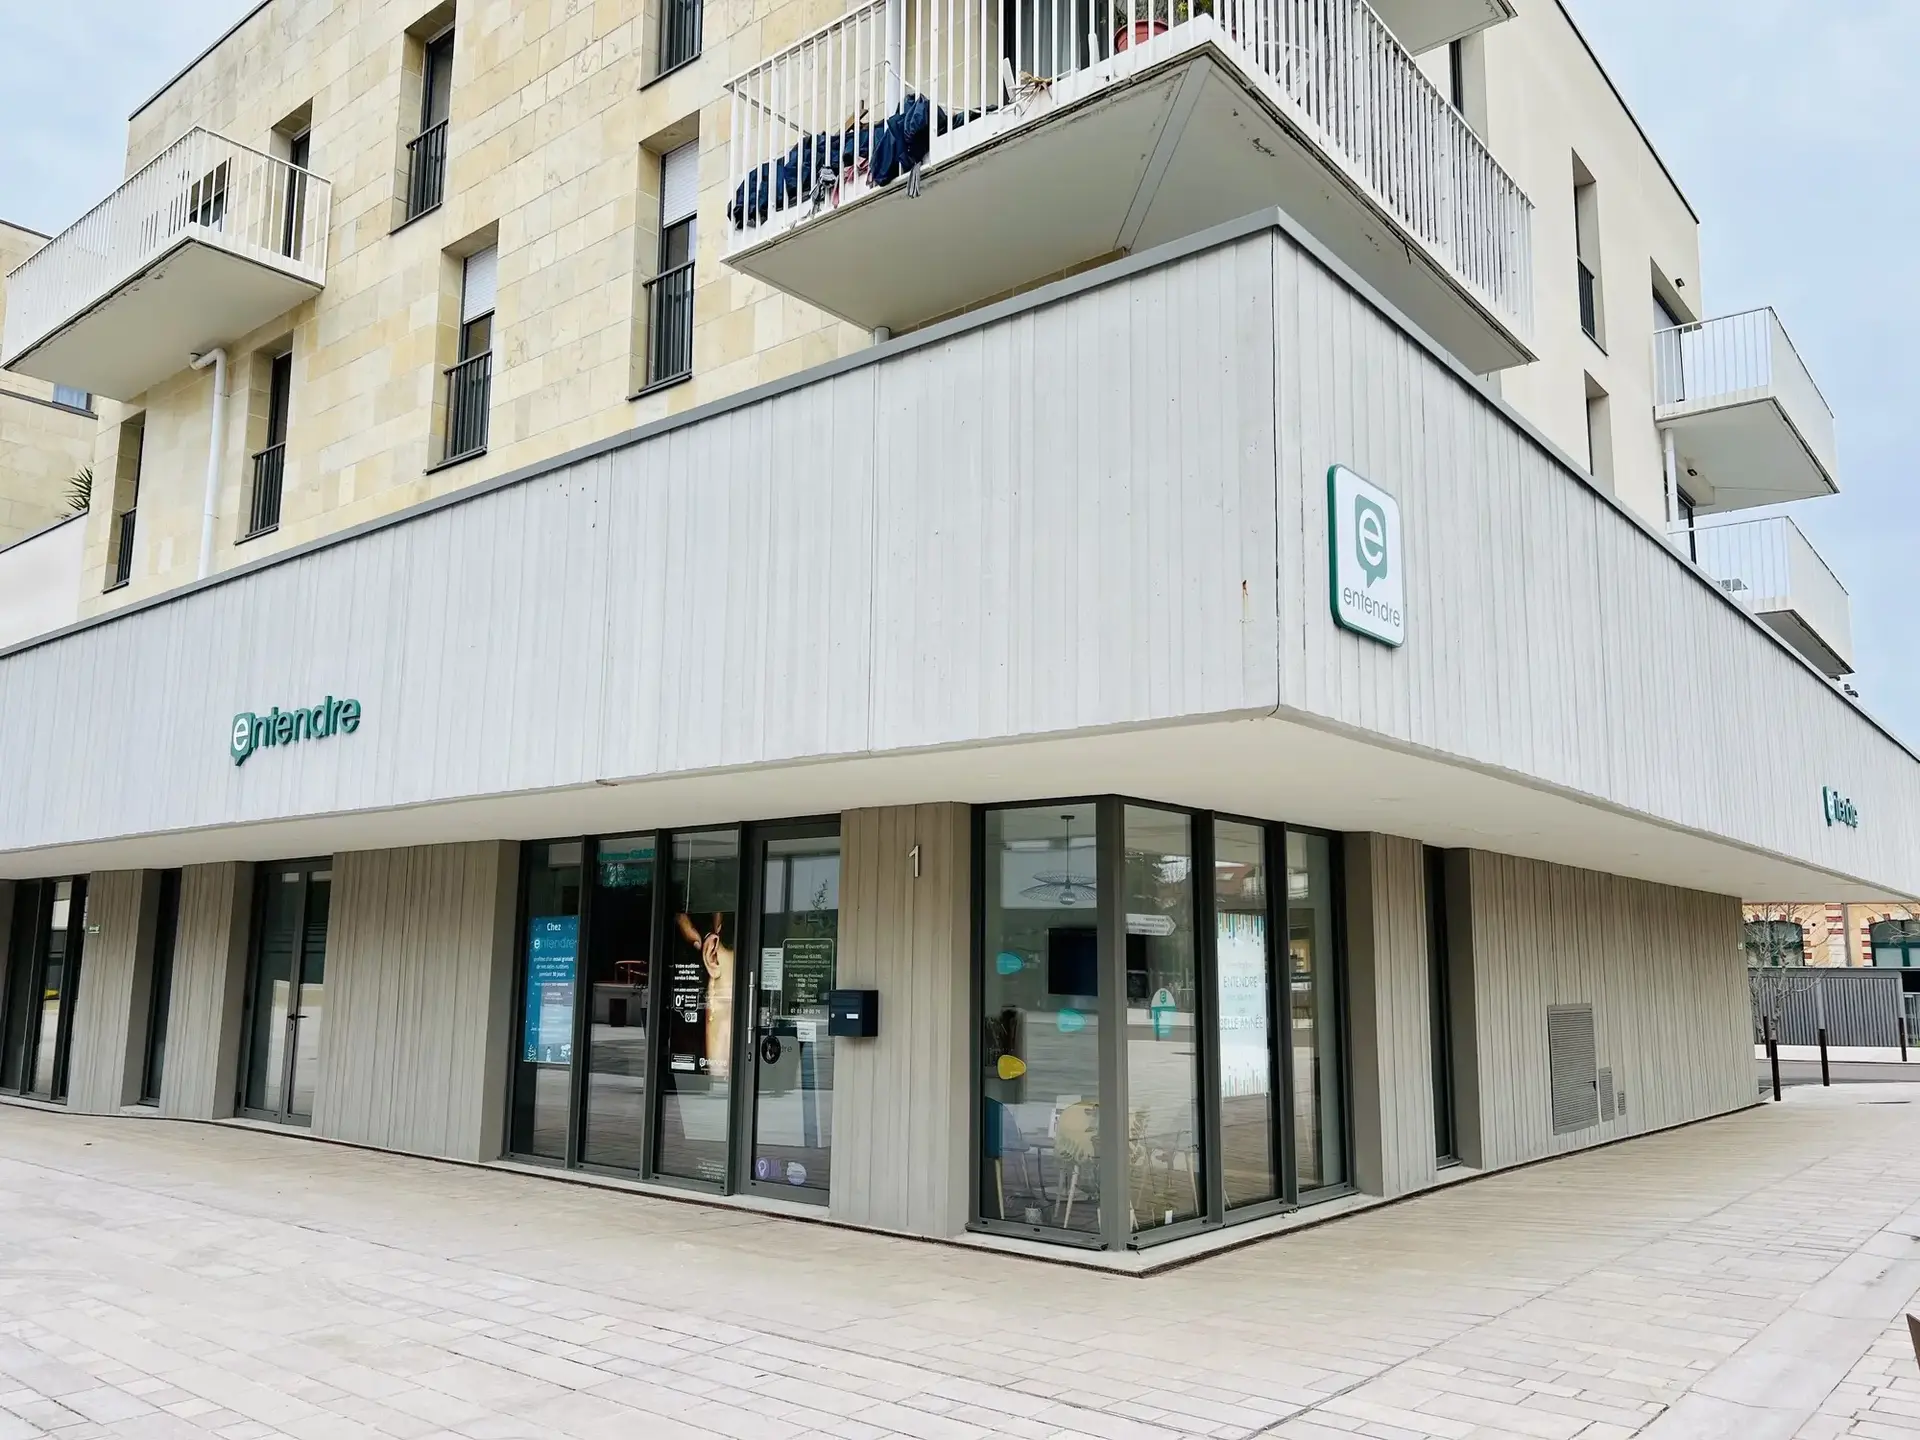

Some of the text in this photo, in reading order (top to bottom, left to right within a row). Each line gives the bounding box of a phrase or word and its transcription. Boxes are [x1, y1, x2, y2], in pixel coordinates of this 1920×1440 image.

[1343, 587, 1401, 627] entendre
[231, 695, 361, 764] entendre
[908, 845, 920, 878] 1
[546, 922, 562, 931] Chez
[533, 937, 576, 950] entendre
[1223, 975, 1258, 988] ENTENDRE
